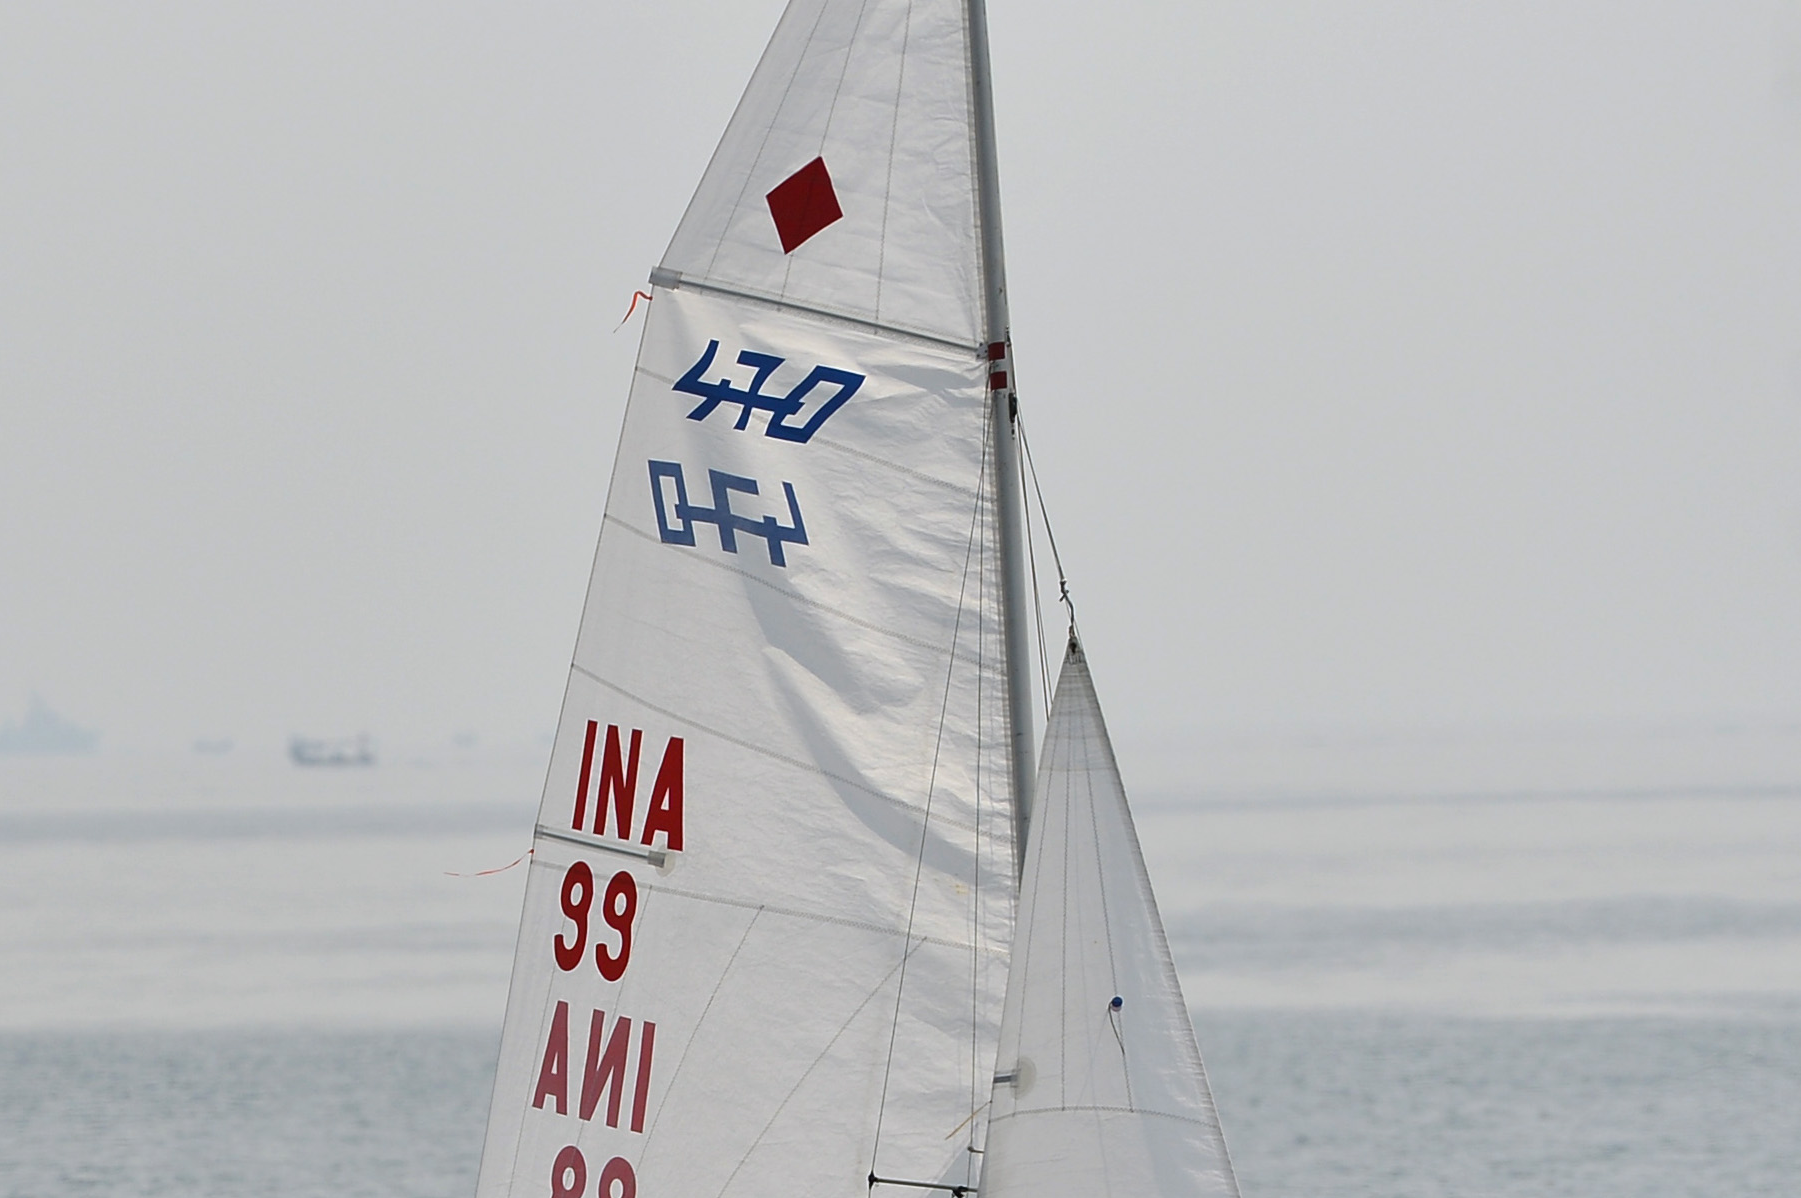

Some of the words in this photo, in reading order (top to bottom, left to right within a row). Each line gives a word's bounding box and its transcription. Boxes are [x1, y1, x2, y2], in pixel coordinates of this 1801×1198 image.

[672, 339, 866, 443] 470
[571, 719, 684, 851] INA
[554, 861, 637, 982] 99
